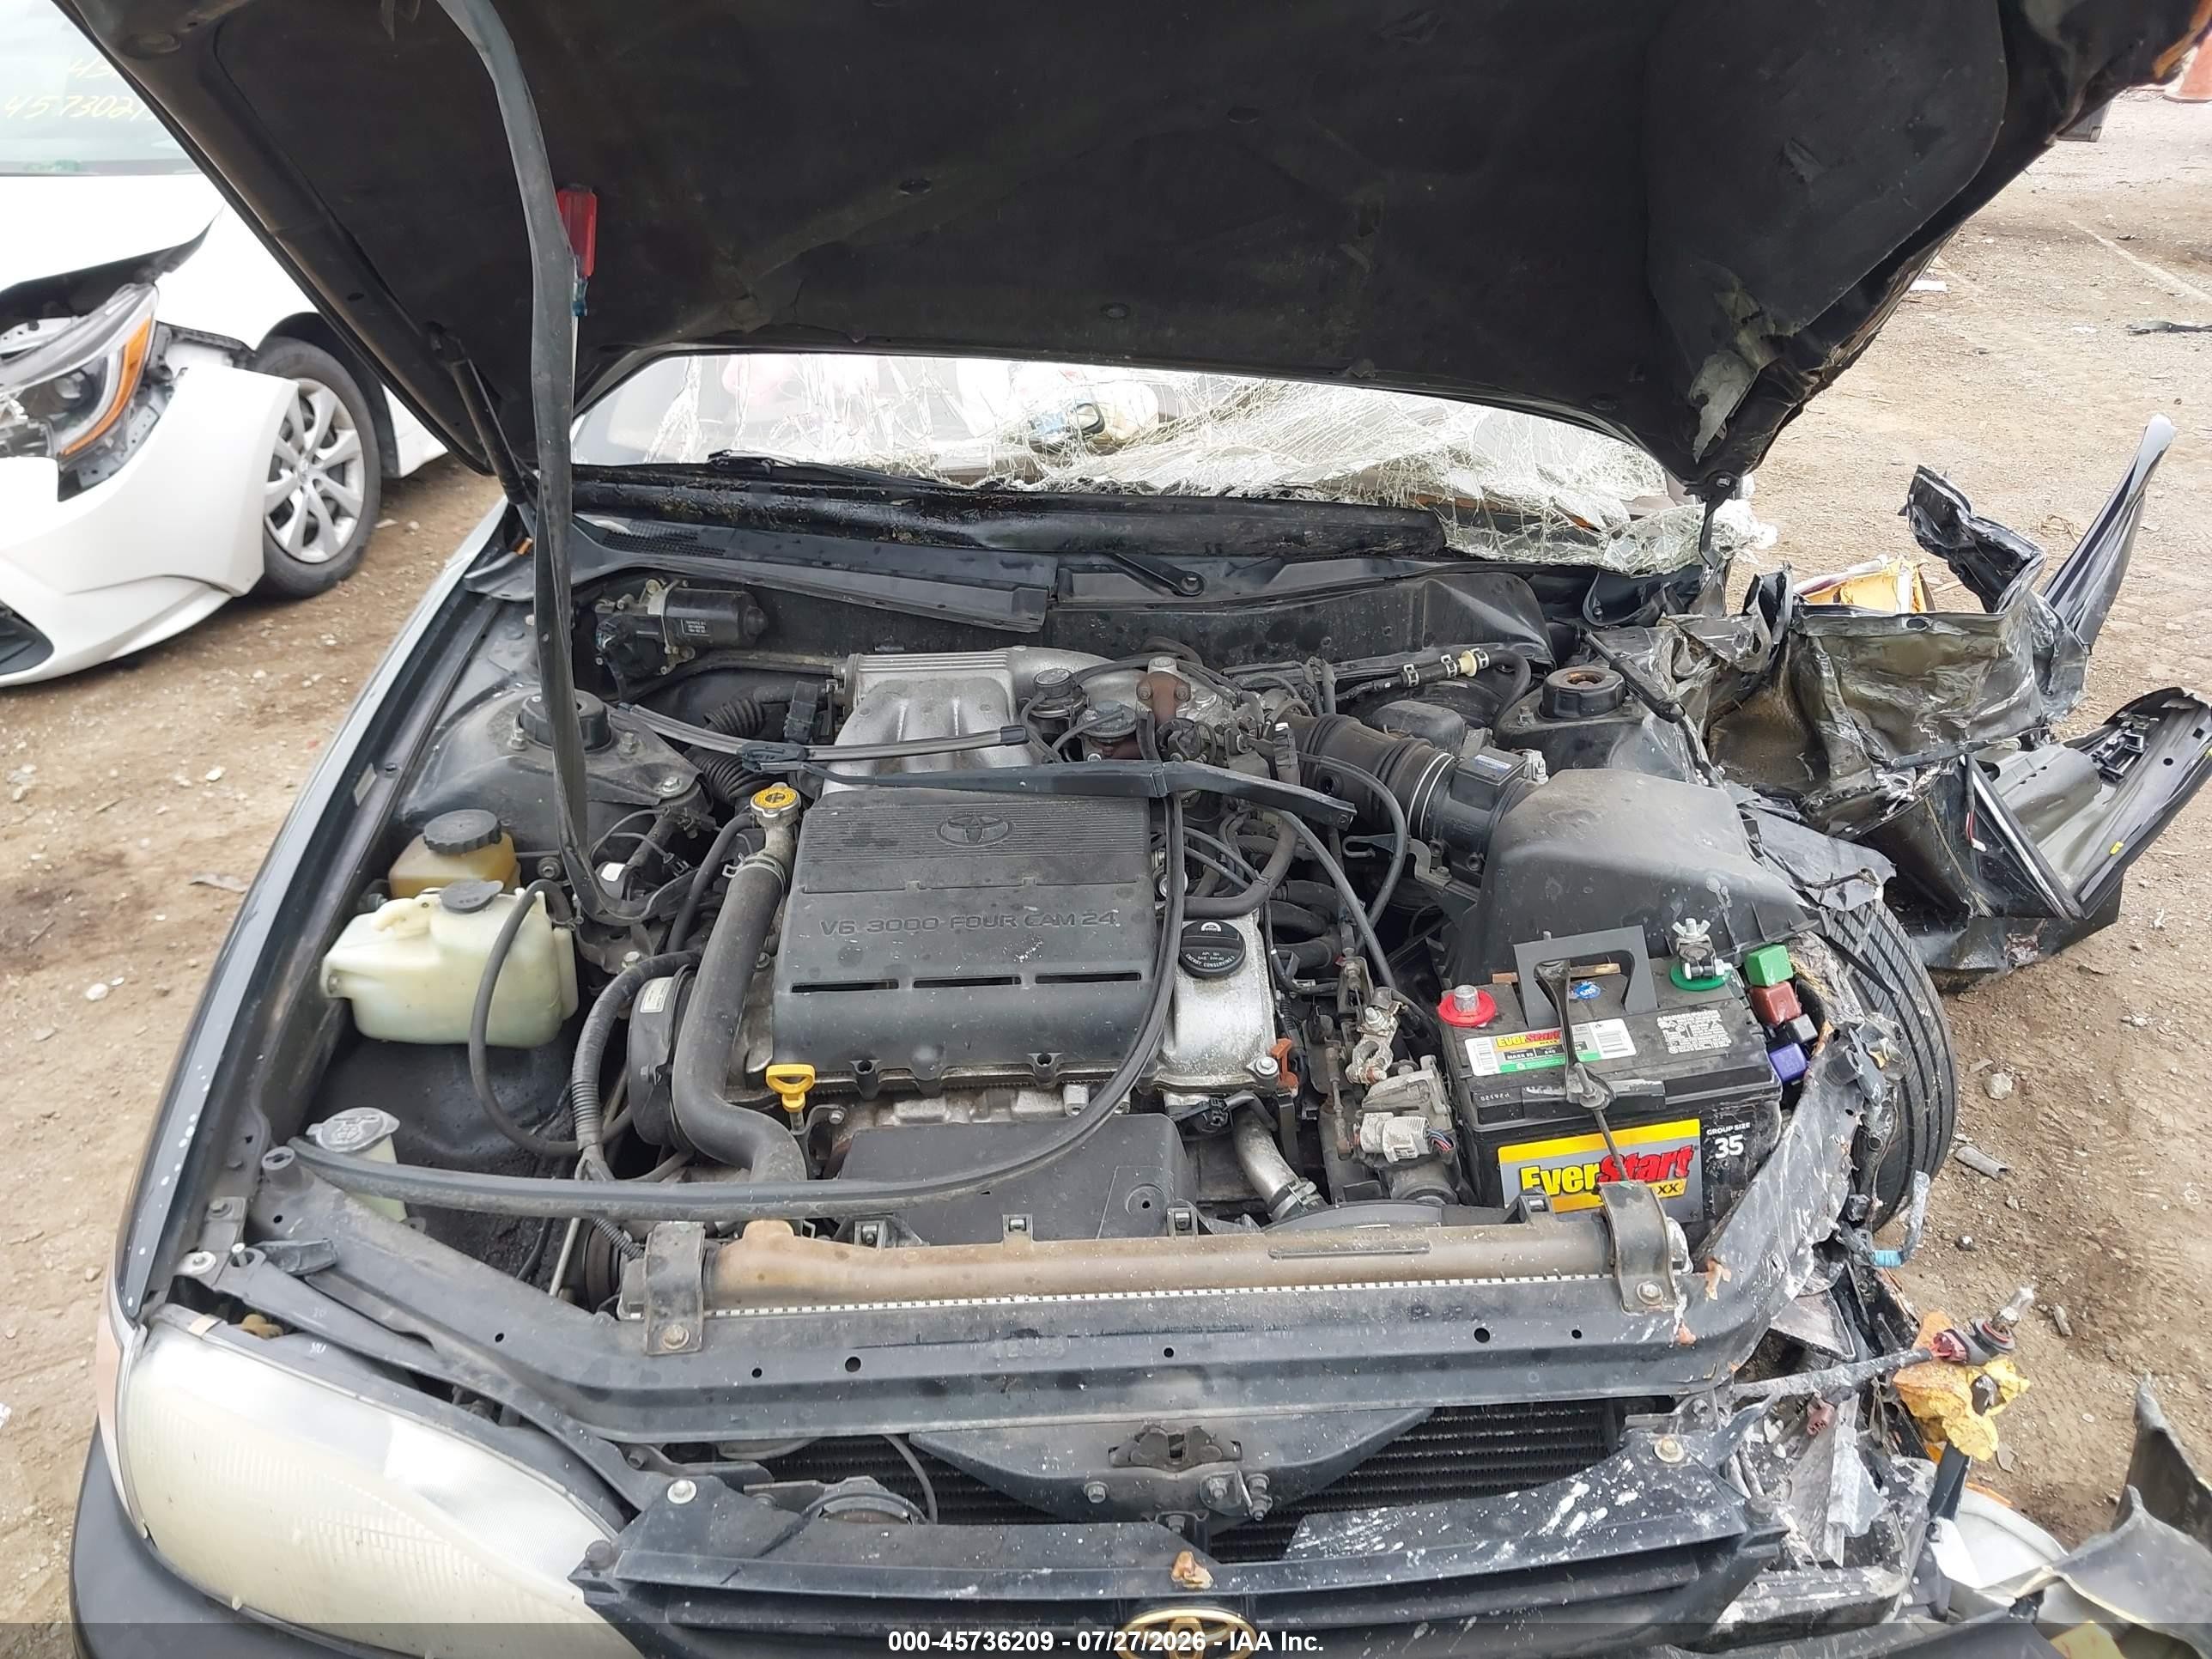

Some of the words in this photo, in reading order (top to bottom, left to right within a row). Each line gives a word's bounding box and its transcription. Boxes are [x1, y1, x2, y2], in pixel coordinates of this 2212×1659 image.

[820, 919, 856, 936] V6
[866, 917, 940, 934] 3000
[950, 914, 1018, 929] FOUR
[1024, 912, 1076, 928] CAM
[1082, 911, 1118, 927] 24
[1706, 1125, 1731, 1136] GROUP
[1734, 1121, 1751, 1131] SIZE
[1714, 1134, 1745, 1160] 35
[1519, 1145, 1695, 1196] EverStart
